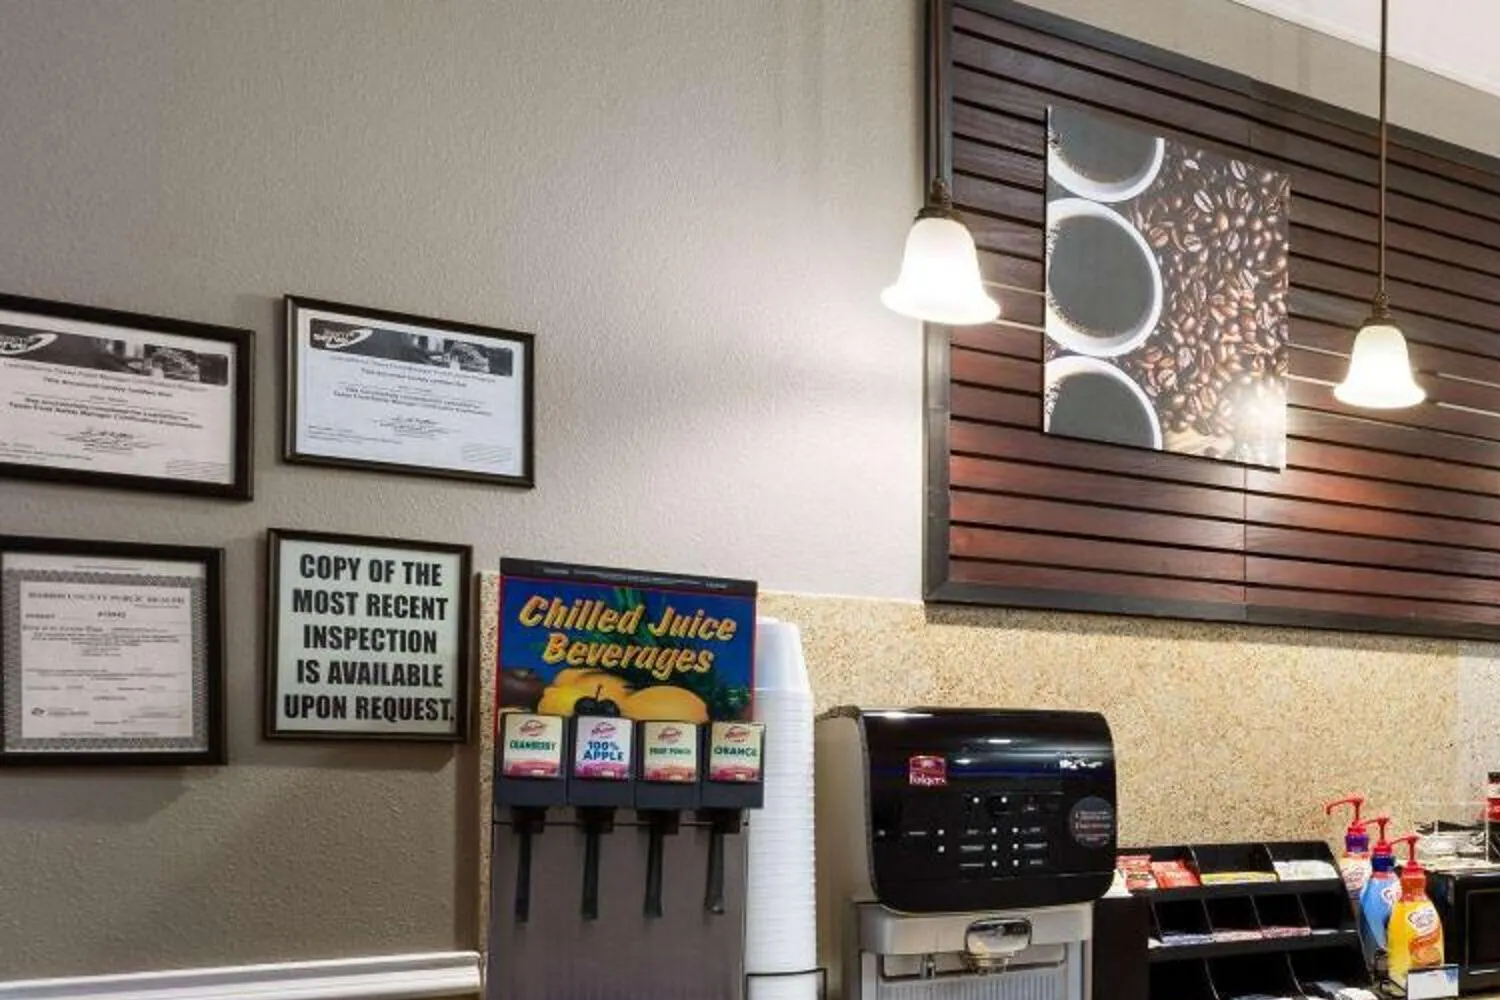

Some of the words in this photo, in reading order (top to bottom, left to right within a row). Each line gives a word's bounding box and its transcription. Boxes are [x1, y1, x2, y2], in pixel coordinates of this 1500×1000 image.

[300, 554, 361, 581] COPY
[368, 559, 396, 583] OF
[402, 561, 443, 587] THE
[292, 588, 359, 616] MOST
[366, 593, 449, 620] RECENT
[518, 594, 646, 635] Chilled
[648, 605, 737, 641] Juice
[303, 624, 437, 653] INSPECTION
[541, 631, 715, 681] Beverages
[297, 659, 321, 684] IS
[327, 660, 443, 687] AVAILABLE
[284, 693, 347, 719] UPON
[355, 696, 455, 723] REQUEST.
[583, 751, 624, 761] APPLE
[587, 741, 620, 751] 100%
[713, 746, 758, 757] ORANGE
